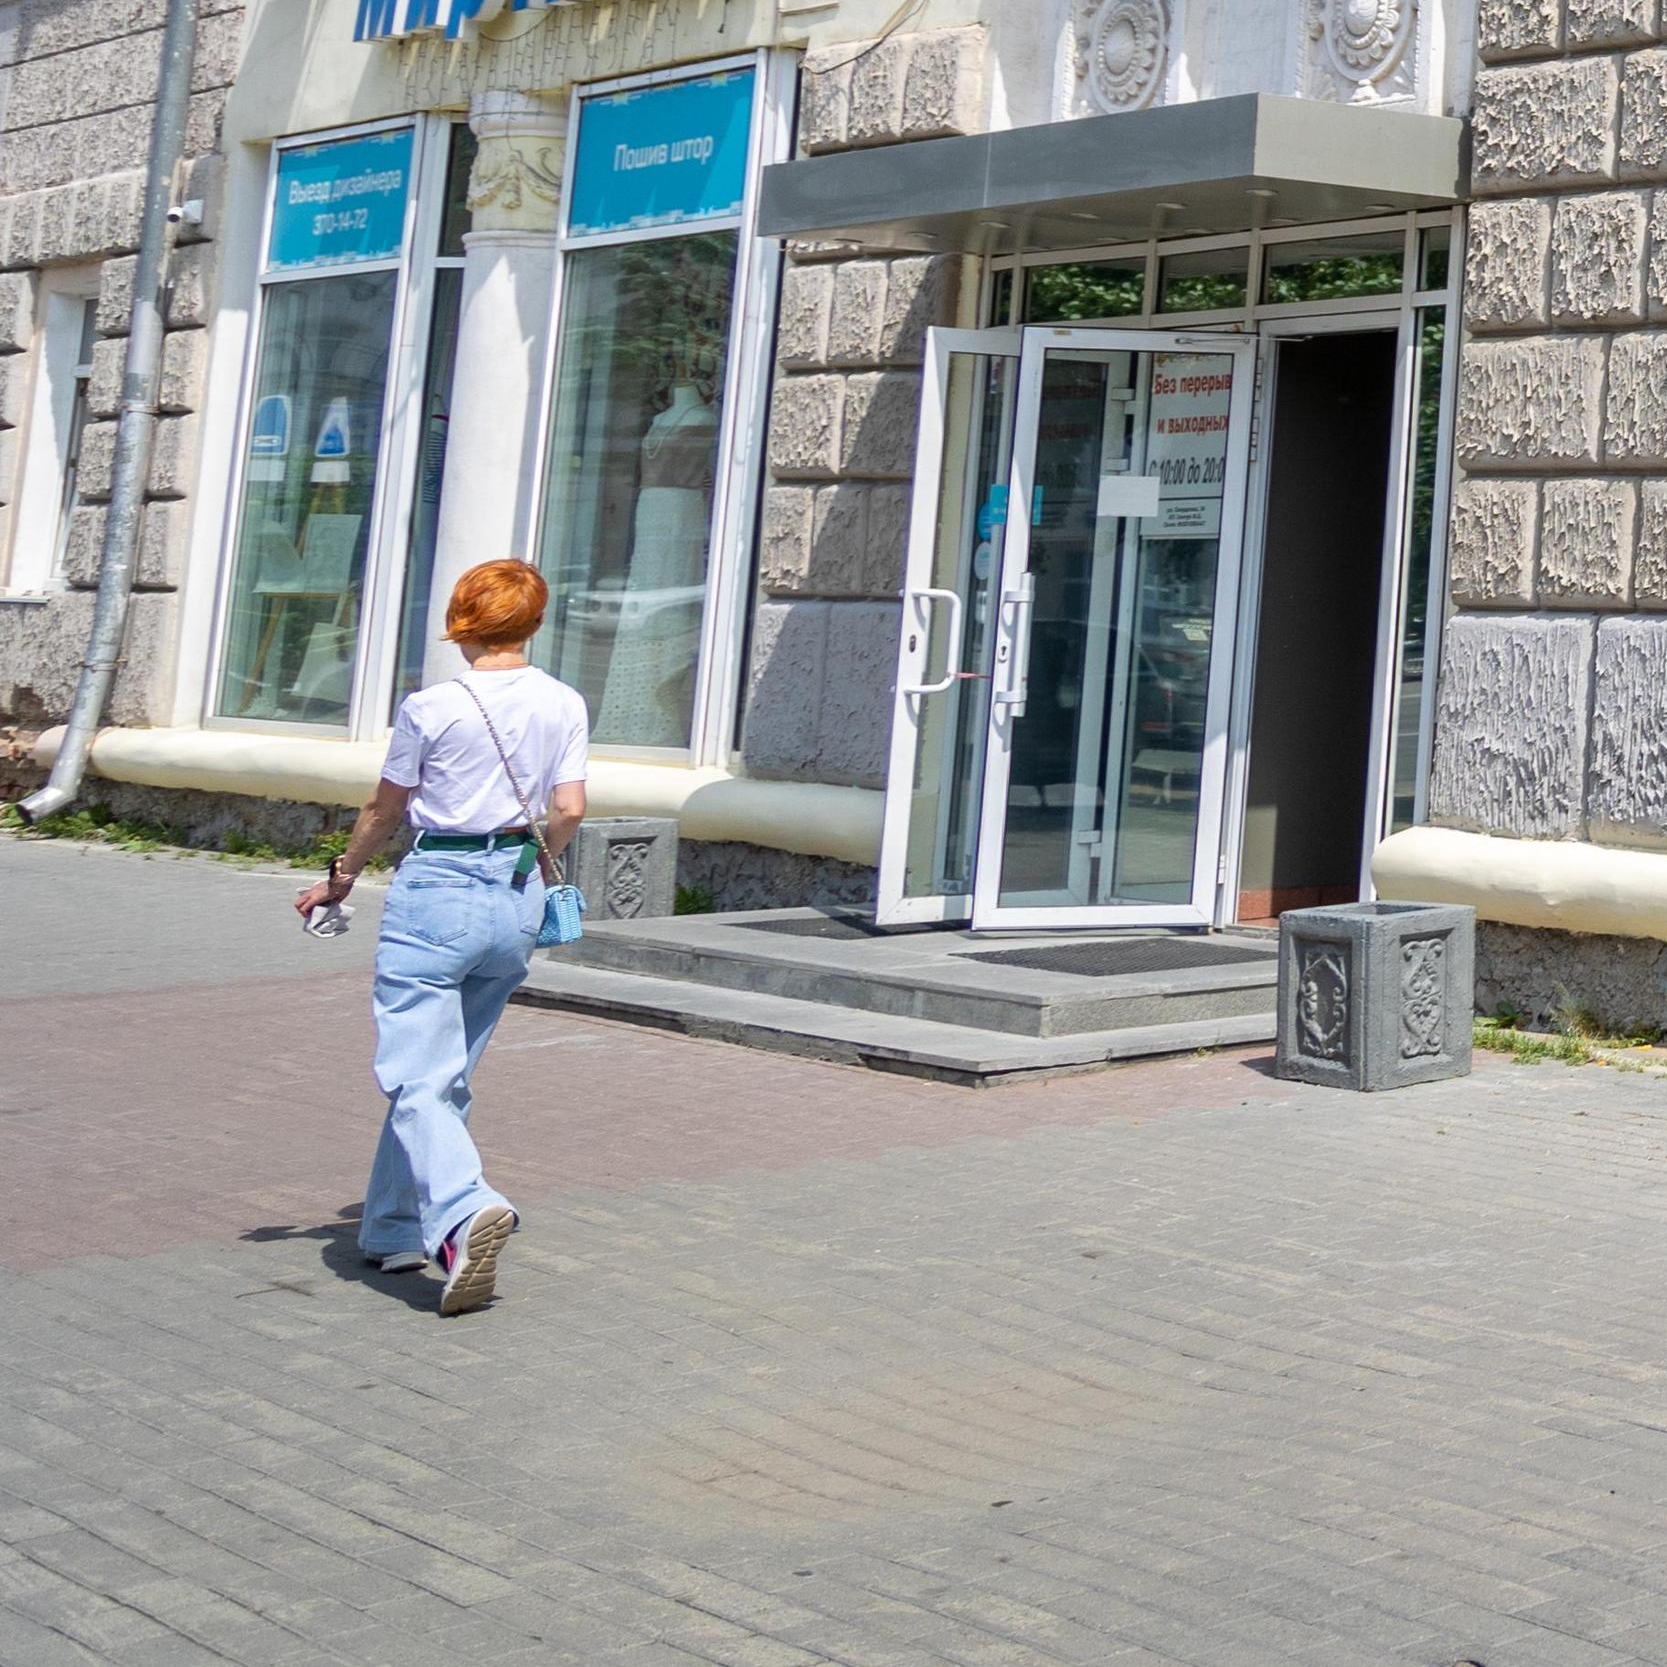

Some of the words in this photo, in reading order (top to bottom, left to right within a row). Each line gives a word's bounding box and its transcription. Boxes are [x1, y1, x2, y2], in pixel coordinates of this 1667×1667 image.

[613, 143, 668, 172] Пошив
[670, 135, 714, 166] штор
[288, 180, 331, 204] Выезд
[331, 168, 402, 202] дизайнера
[1154, 374, 1176, 395] Без
[1157, 418, 1165, 434] и
[1187, 456, 1200, 485] до
